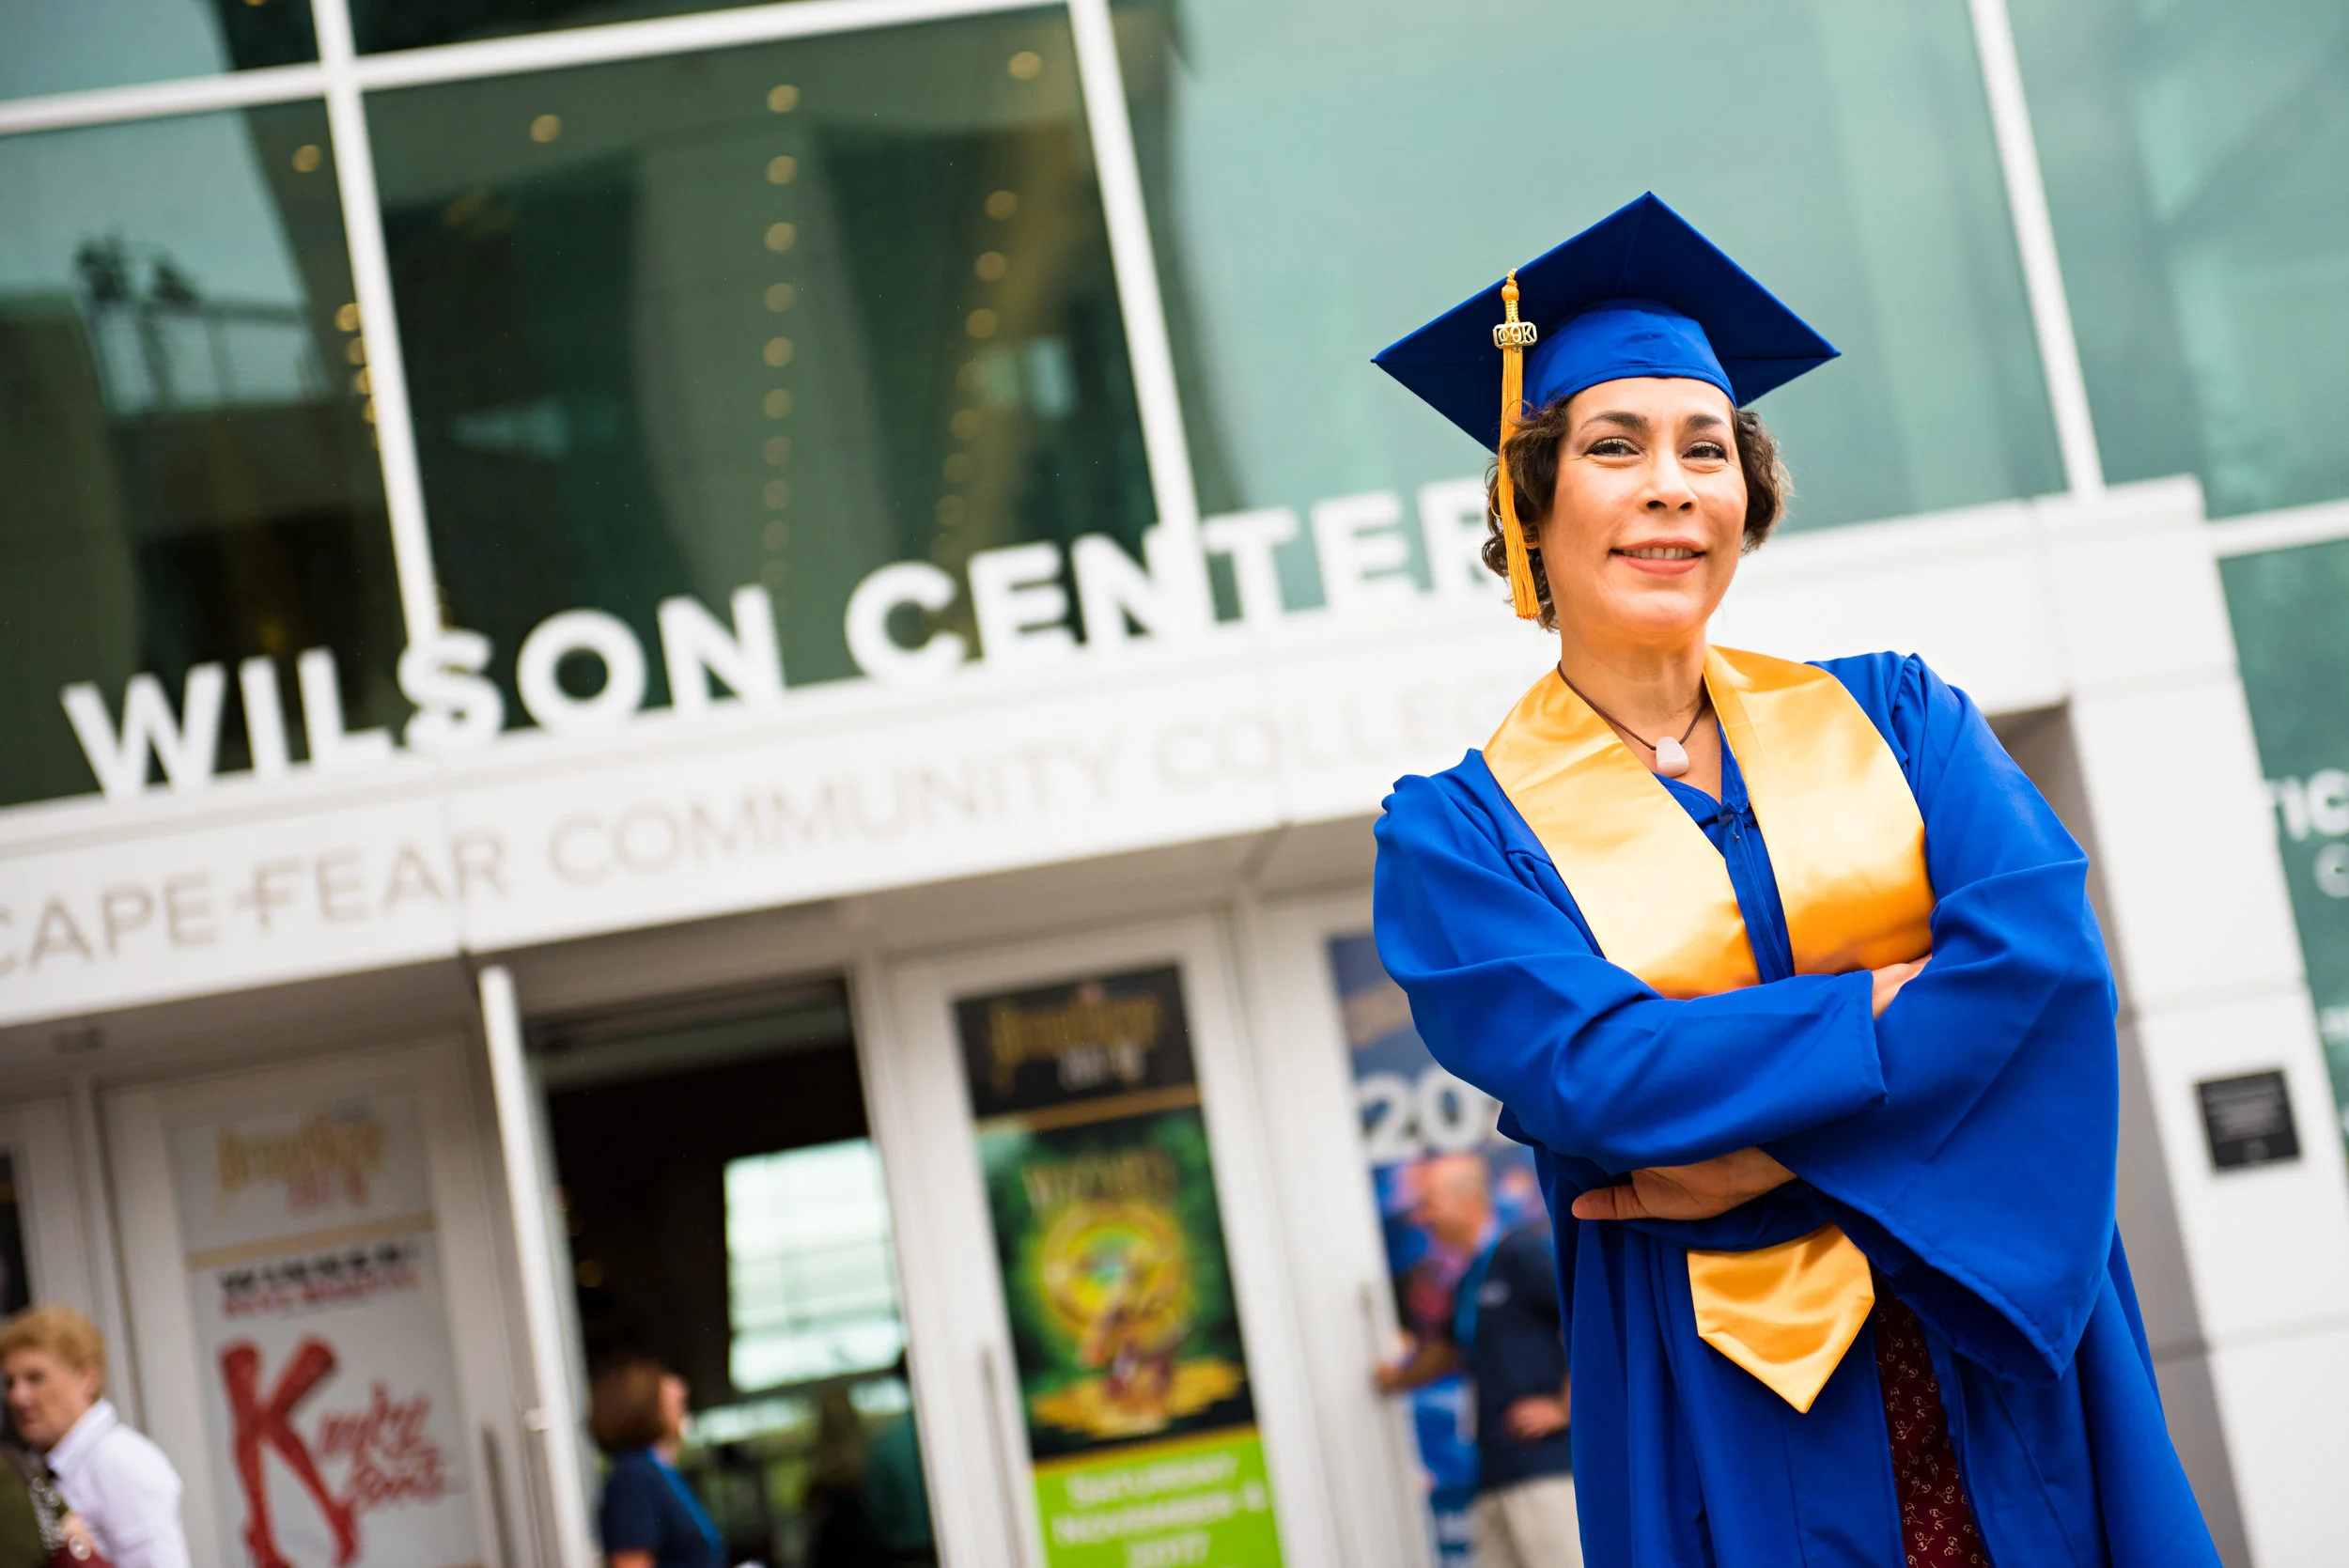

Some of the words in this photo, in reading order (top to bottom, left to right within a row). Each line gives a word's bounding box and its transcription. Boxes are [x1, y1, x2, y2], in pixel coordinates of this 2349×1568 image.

[61, 584, 786, 799] WILSON
[844, 475, 1498, 684] CENTER
[235, 829, 509, 934] FEAR
[548, 737, 1126, 888] COMMUNITY
[1151, 662, 1541, 794] COLLEG
